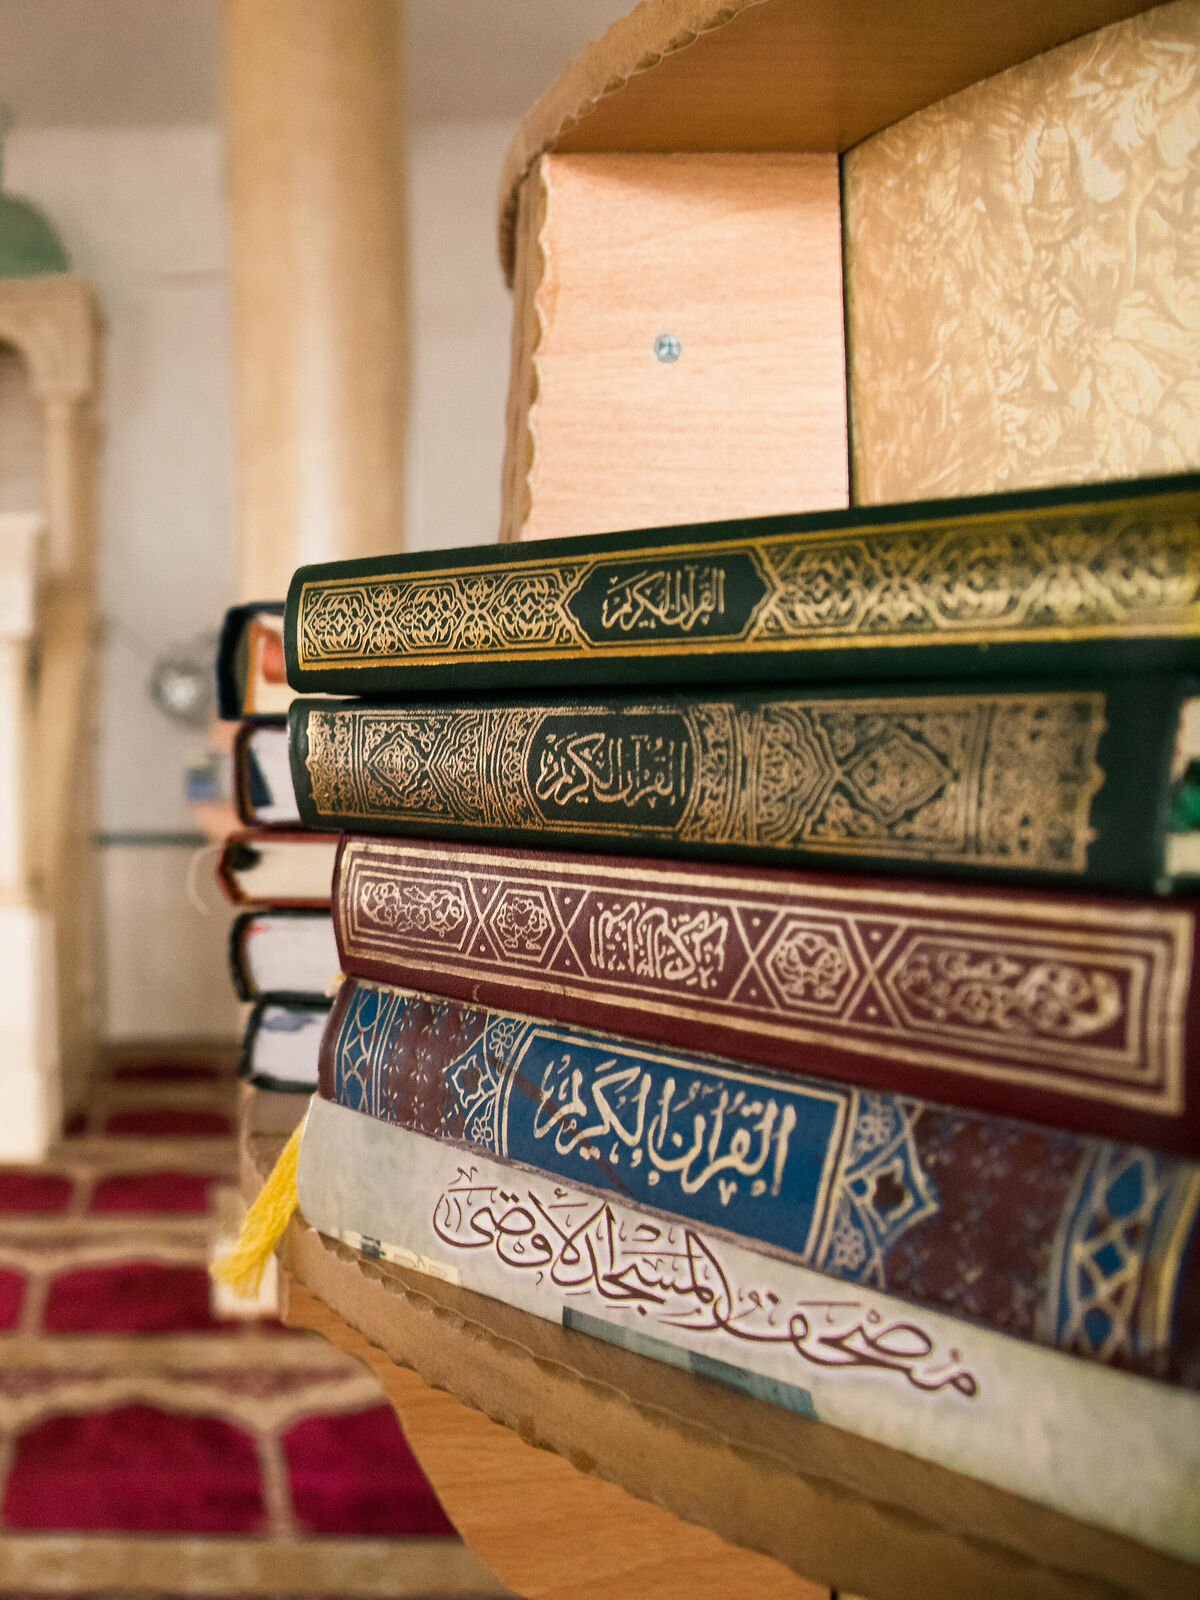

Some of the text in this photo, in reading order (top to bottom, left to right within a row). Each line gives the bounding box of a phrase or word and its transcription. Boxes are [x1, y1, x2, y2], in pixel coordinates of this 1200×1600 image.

[602, 565, 725, 632] القرآن الكريم
[536, 732, 688, 808] القرآن الكريم
[647, 909, 728, 988] الكريم
[533, 1055, 796, 1203] القرآن الكريم
[551, 1223, 733, 1325] المسجد
[713, 1290, 978, 1399] مصحف
